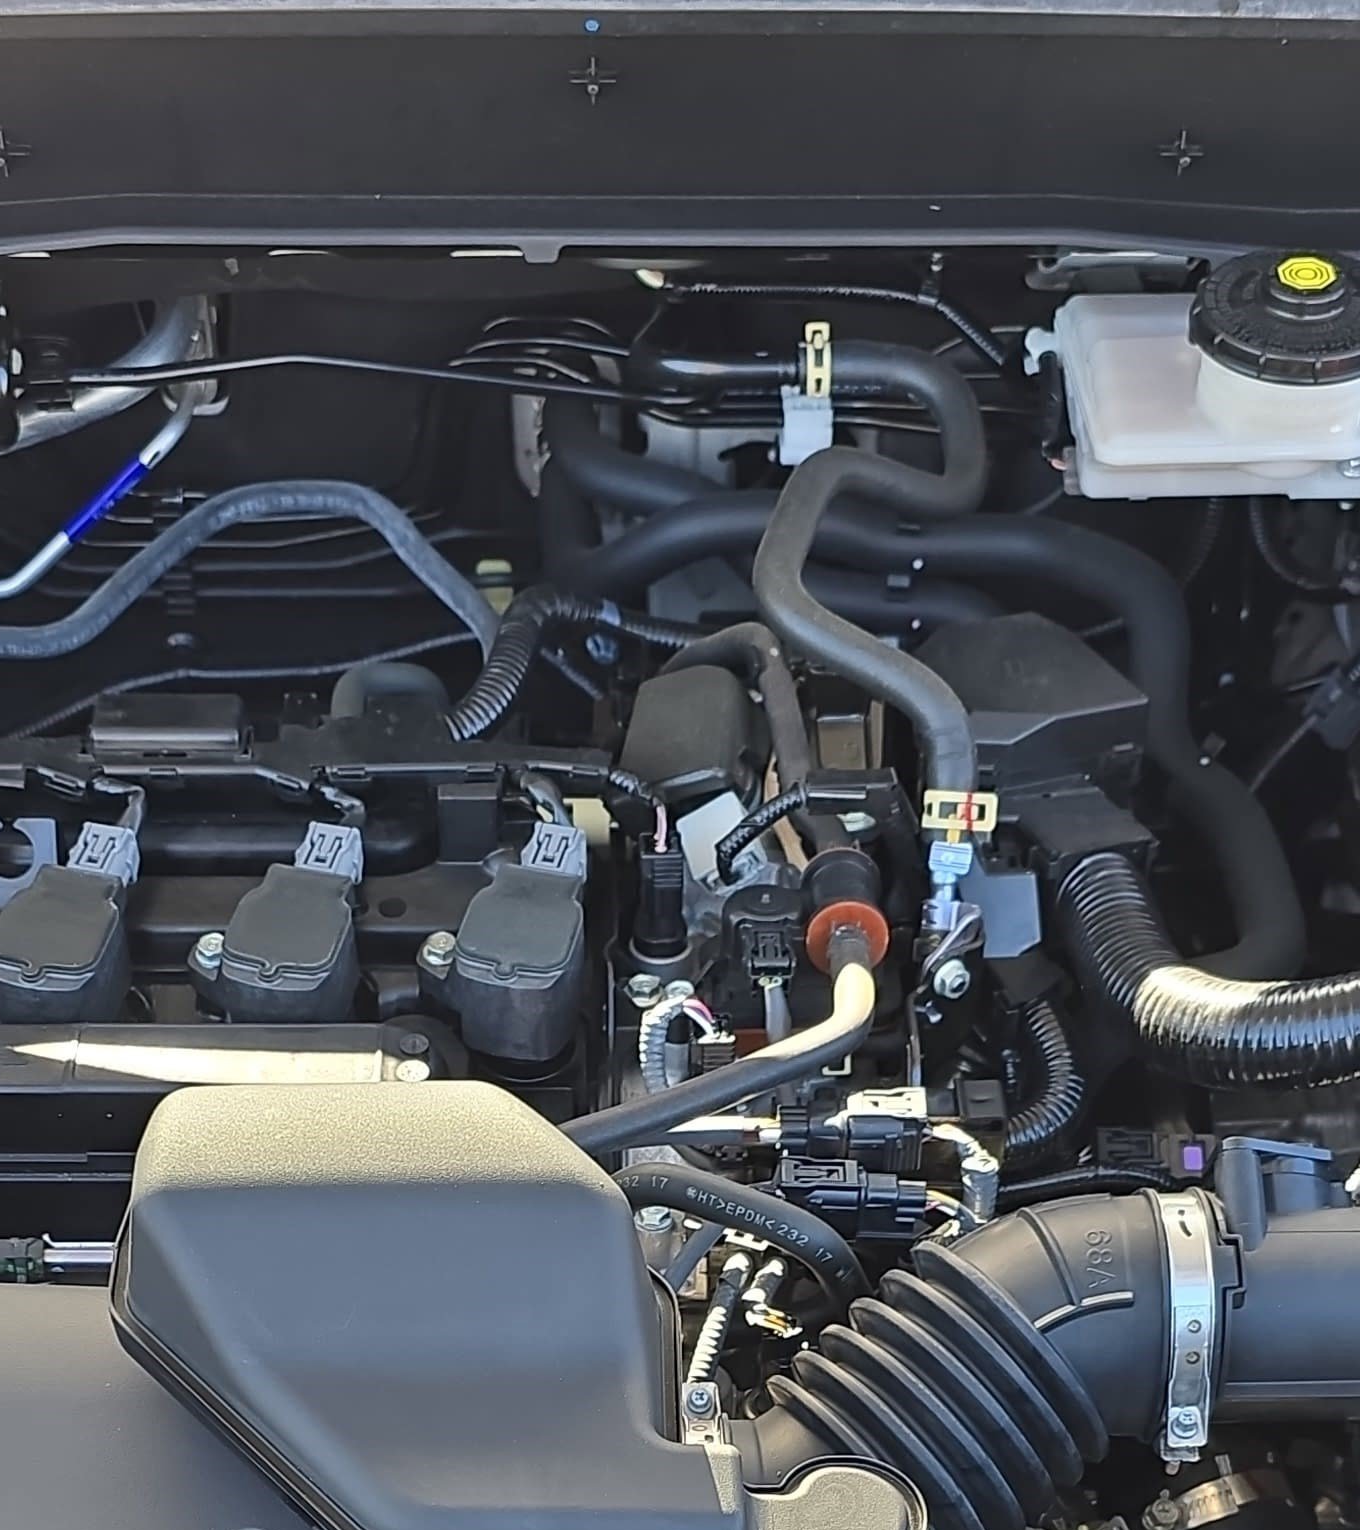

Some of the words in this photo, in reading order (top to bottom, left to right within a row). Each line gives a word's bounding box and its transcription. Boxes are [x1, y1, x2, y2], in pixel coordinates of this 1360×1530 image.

[650, 1175, 670, 1190] 17
[776, 1223, 810, 1248] 232
[814, 1246, 833, 1264] 17
